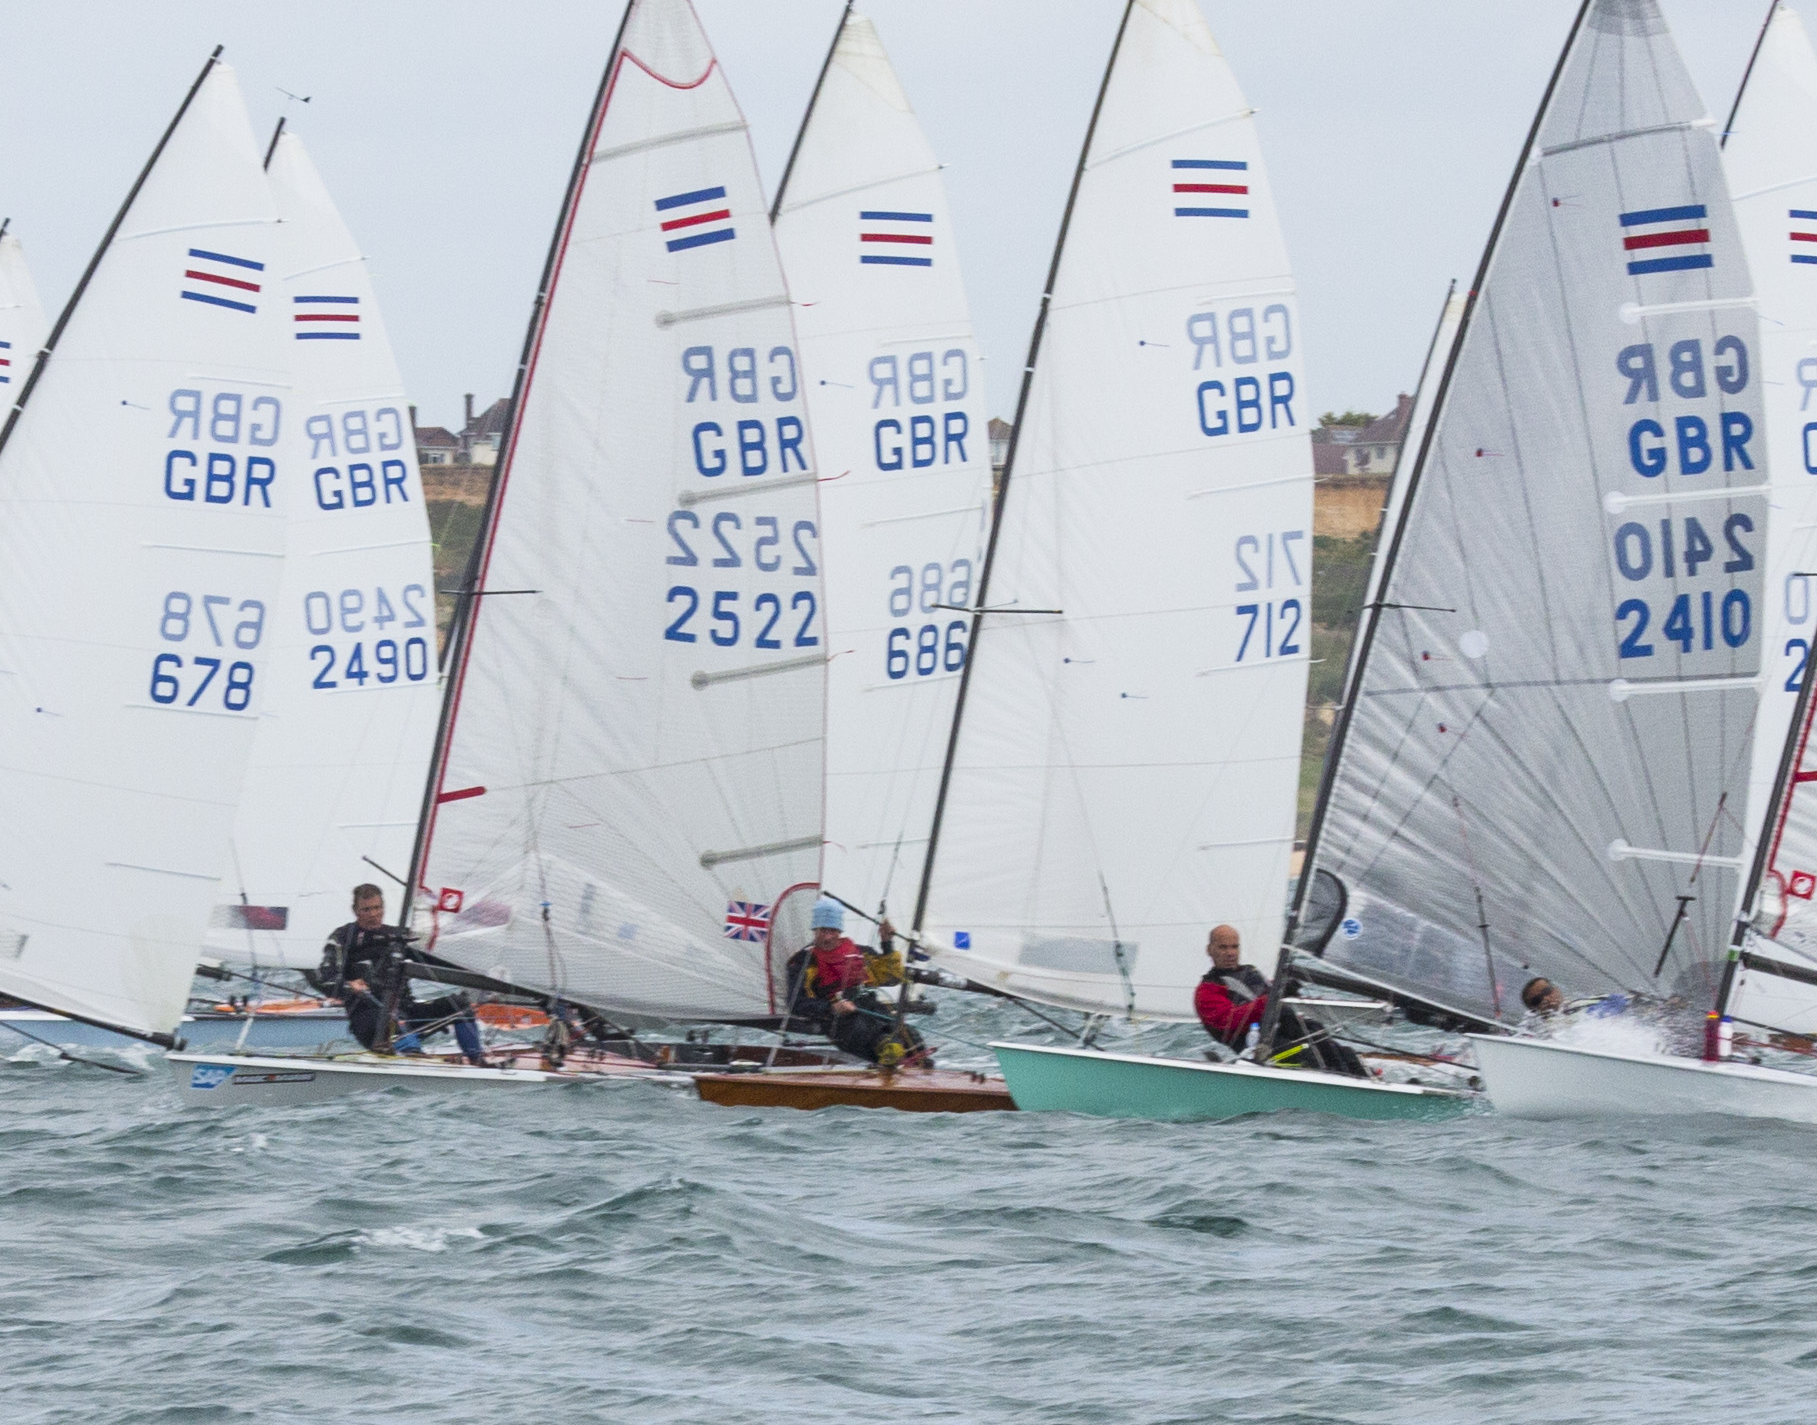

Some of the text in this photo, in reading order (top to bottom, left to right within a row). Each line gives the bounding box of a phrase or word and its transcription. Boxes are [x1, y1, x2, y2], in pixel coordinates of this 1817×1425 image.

[1196, 371, 1296, 438] GBR
[692, 415, 808, 477] GBR
[874, 411, 969, 472] GBR
[1627, 410, 1756, 478] GBR
[165, 449, 276, 508] GBR
[314, 459, 409, 511] GBR
[664, 585, 819, 650] 2522
[1235, 598, 1302, 663] 712
[1615, 587, 1752, 659] 2410
[310, 637, 427, 689] 2490
[887, 620, 968, 680] 686
[150, 653, 254, 711] 678
